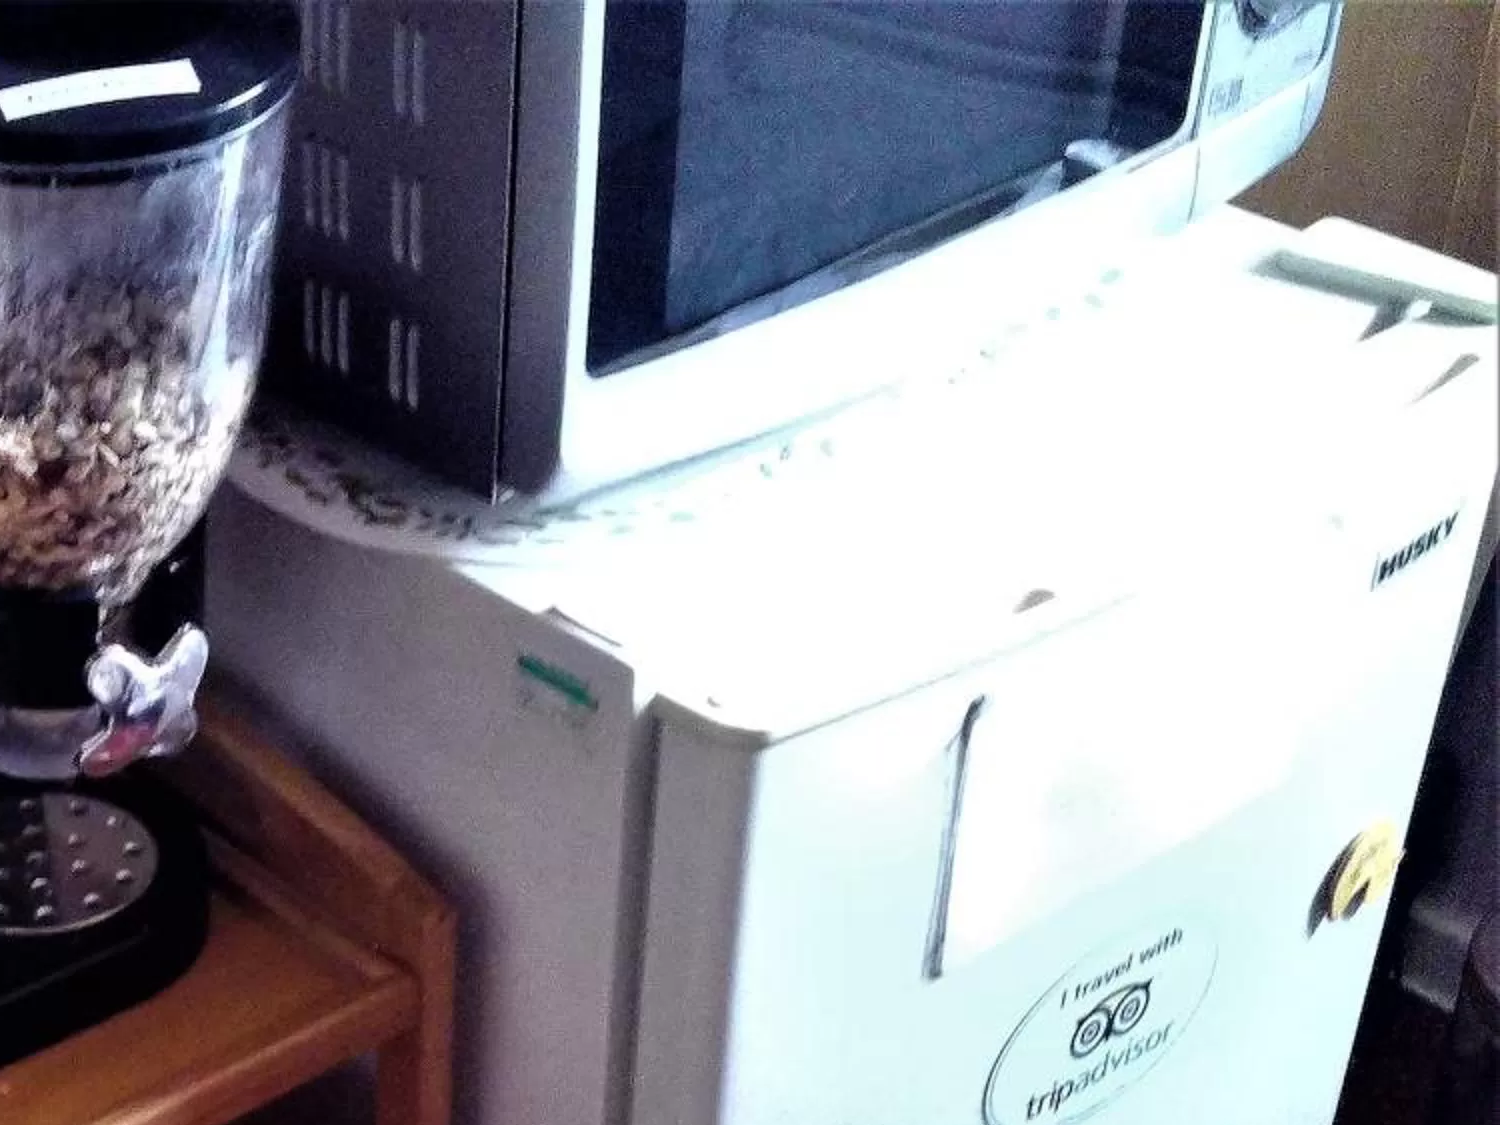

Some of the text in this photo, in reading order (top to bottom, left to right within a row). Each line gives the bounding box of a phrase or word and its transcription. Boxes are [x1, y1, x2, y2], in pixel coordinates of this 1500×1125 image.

[1377, 509, 1459, 585] HUSKY
[1073, 952, 1135, 1003] travel
[1138, 926, 1185, 965] with
[1025, 1019, 1174, 1122] tripadvisor
